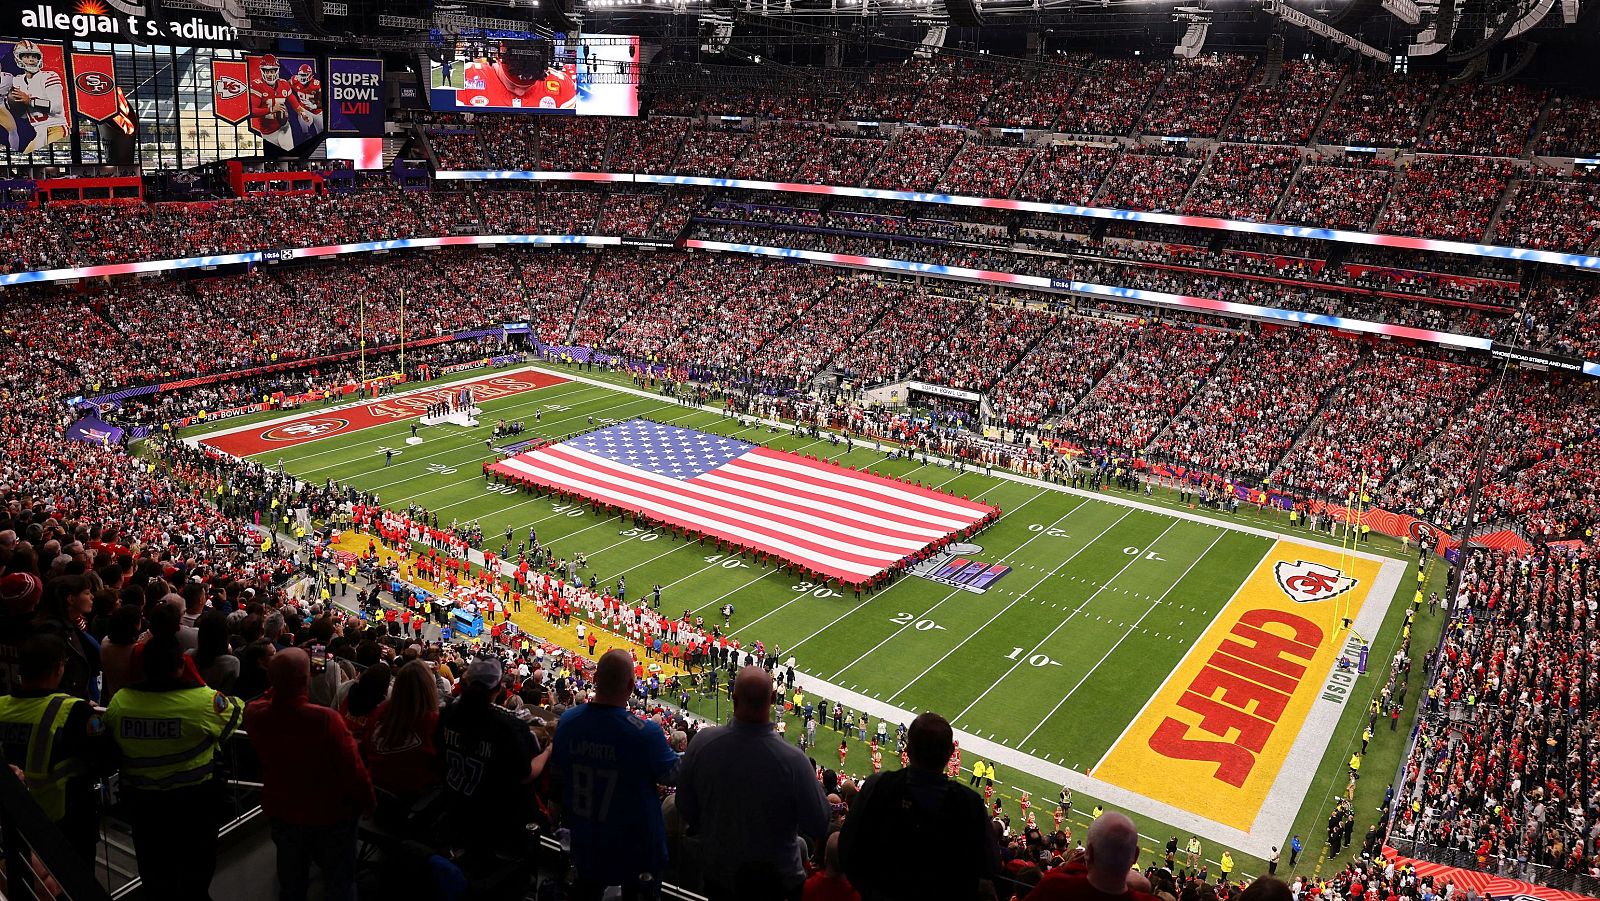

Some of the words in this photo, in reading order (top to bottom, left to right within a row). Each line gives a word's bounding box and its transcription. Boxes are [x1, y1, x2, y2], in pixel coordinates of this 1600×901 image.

[332, 72, 380, 87] SUPER
[333, 87, 379, 101] BOWL
[341, 101, 370, 115] LVIII
[1053, 280, 1069, 288] 10:56
[1549, 360, 1561, 368] AND
[704, 554, 742, 569] 40
[791, 581, 834, 598] 30
[889, 612, 935, 631] 20
[1004, 646, 1050, 667] 10
[1148, 608, 1324, 789] CHIEFS
[124, 719, 176, 738] POLICE
[572, 762, 619, 824] 87
